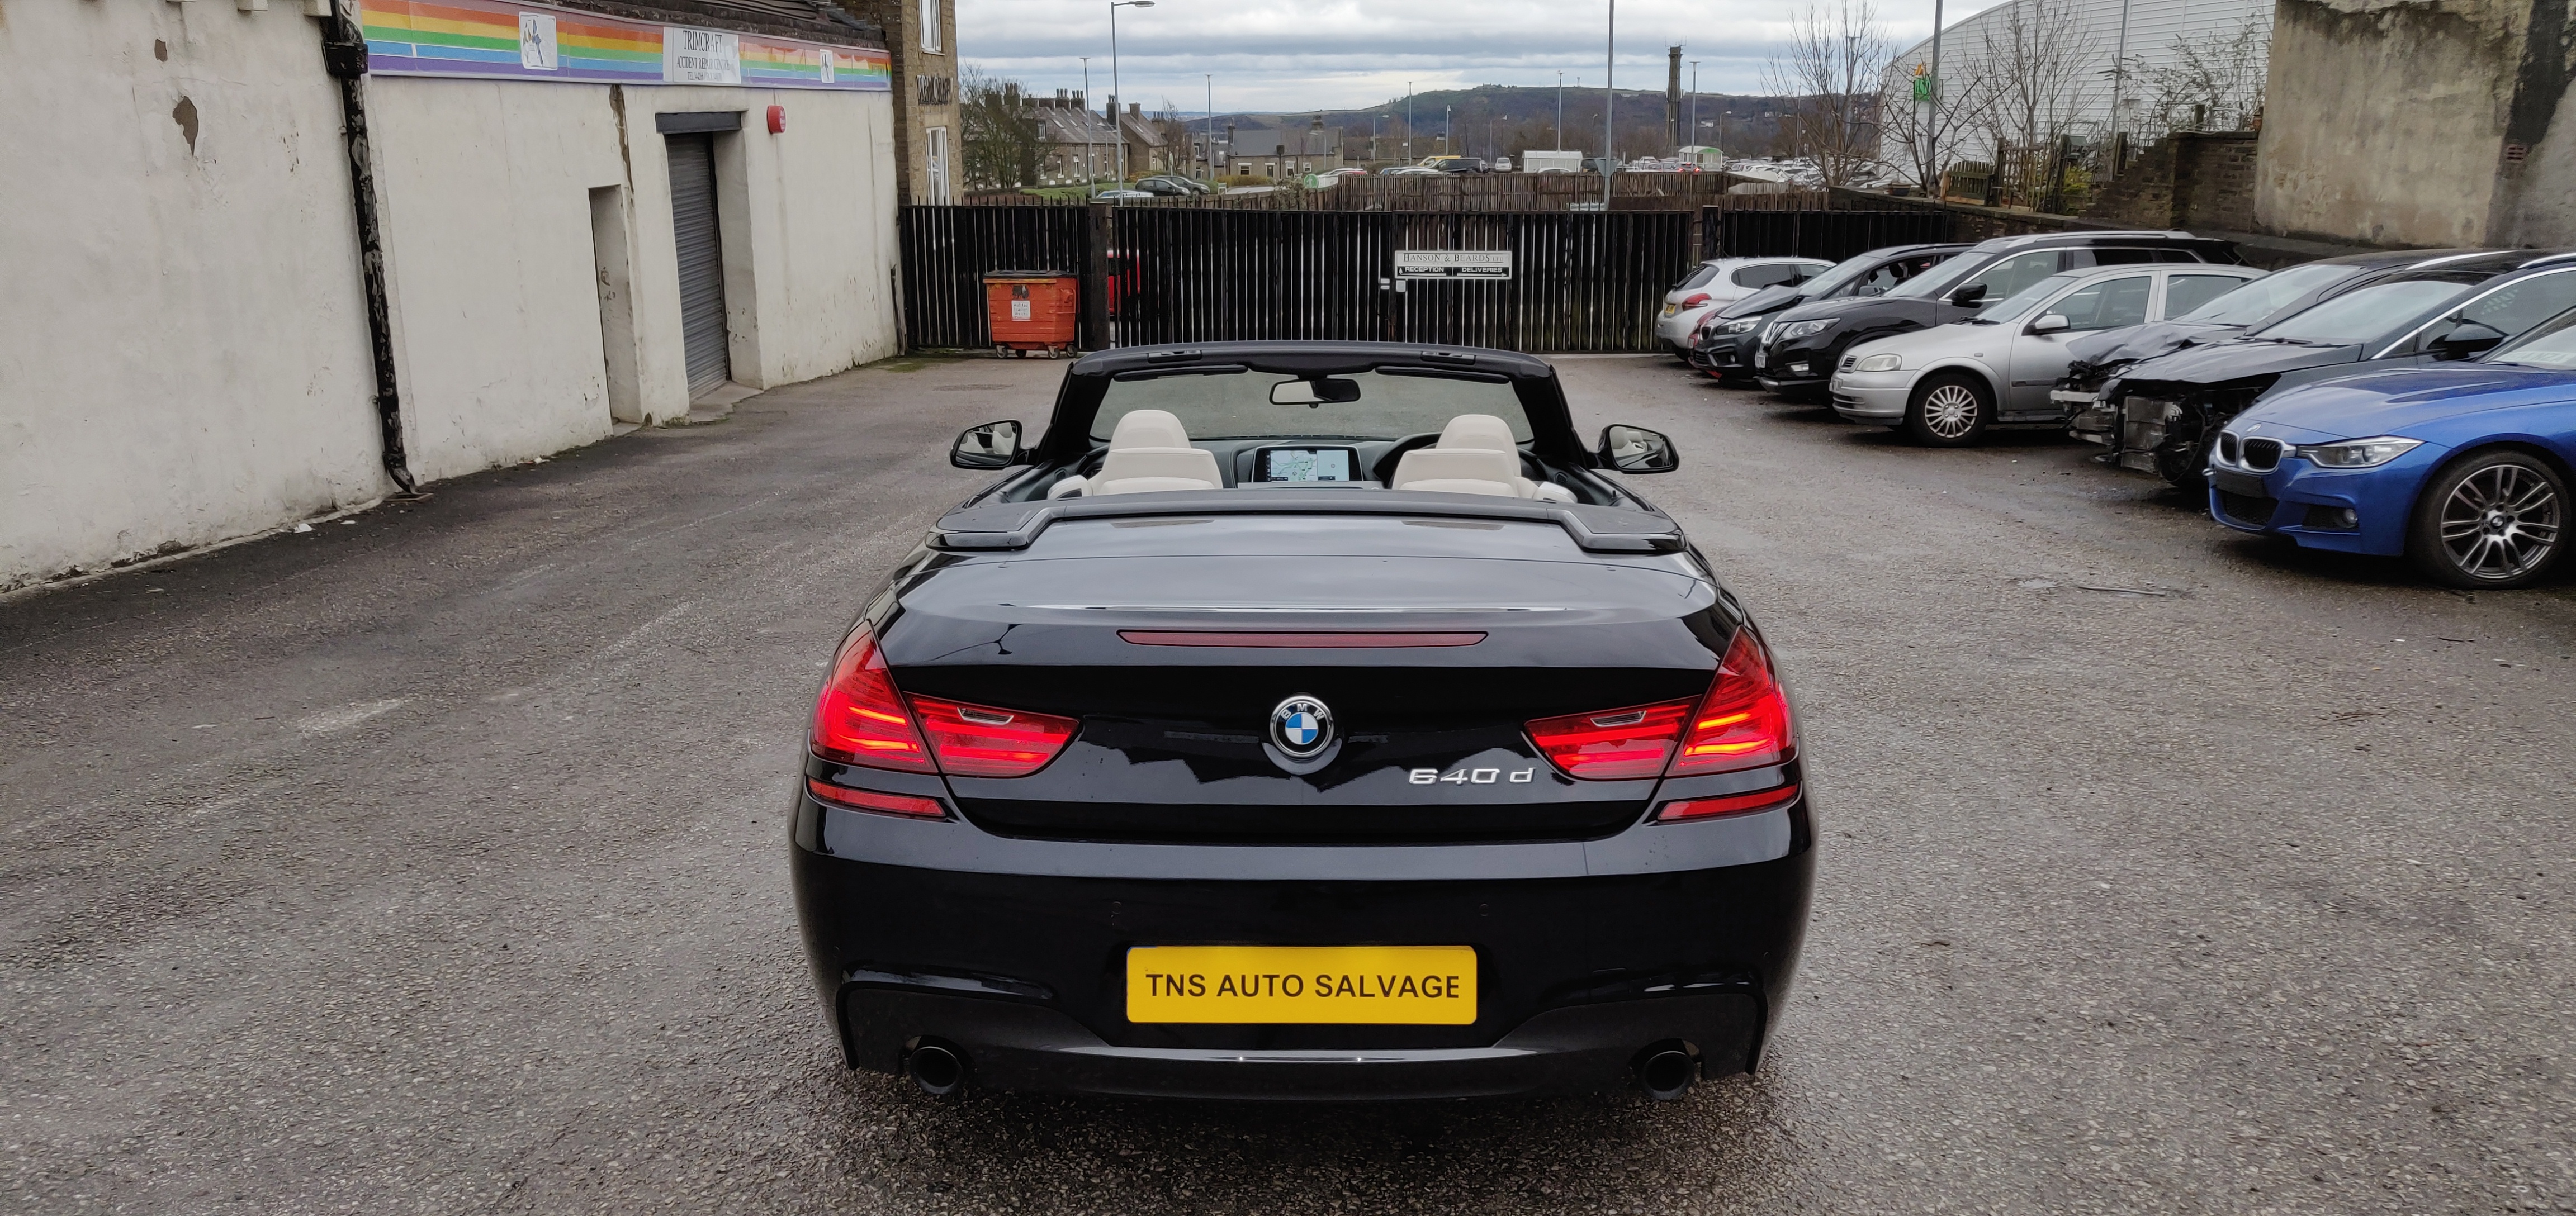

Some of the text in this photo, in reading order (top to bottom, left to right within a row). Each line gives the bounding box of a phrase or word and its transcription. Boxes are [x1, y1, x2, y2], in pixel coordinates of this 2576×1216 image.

[683, 30, 723, 53] TRIMCRAFT
[677, 56, 698, 69] ACCIDENT
[698, 57, 713, 70] REPAIR
[1280, 703, 1325, 721] BMW
[1409, 767, 1536, 785] 640 d
[1145, 974, 1460, 999] TNS AUTO SALVAGE
